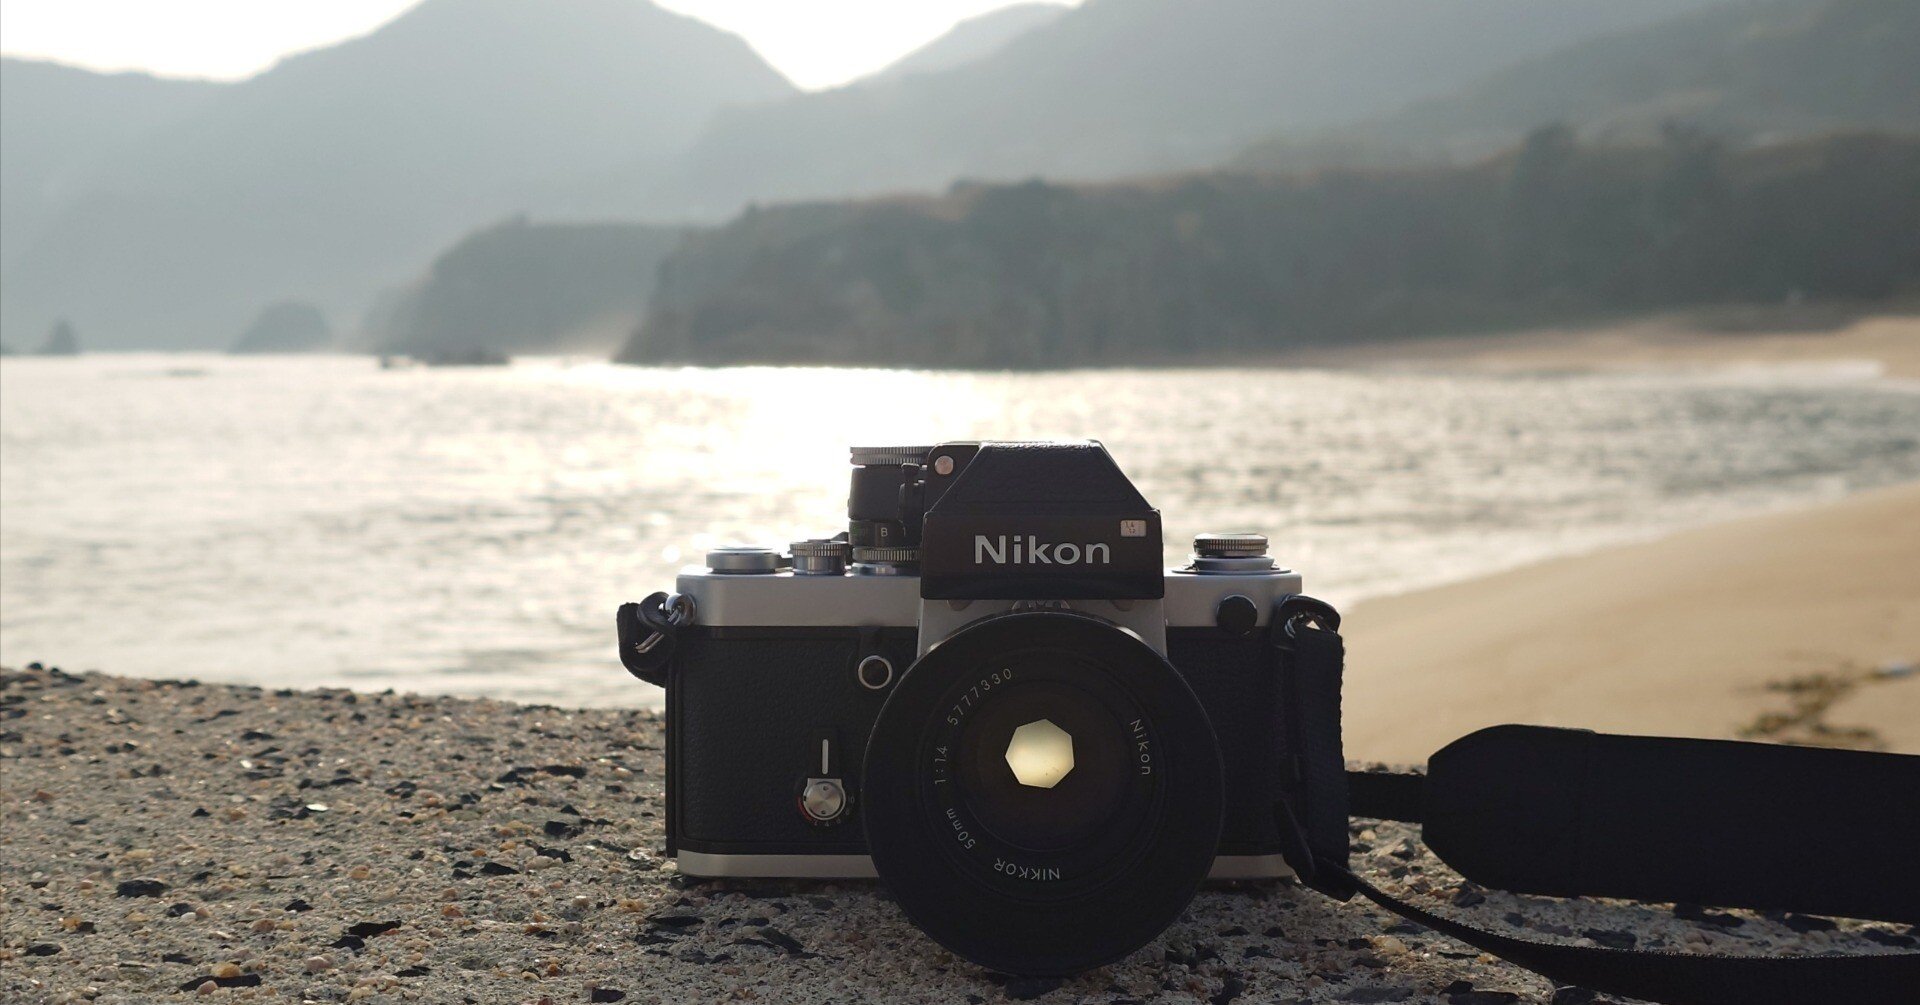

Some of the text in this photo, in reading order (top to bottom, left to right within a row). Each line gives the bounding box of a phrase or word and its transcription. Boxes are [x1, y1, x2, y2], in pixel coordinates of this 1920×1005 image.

[880, 527, 888, 537] B
[974, 535, 1111, 565] Nikon
[946, 668, 1012, 726] 5777330
[1129, 719, 1151, 775] Nikon
[946, 807, 976, 850] 50mm
[993, 857, 1060, 881] NIKKOR
